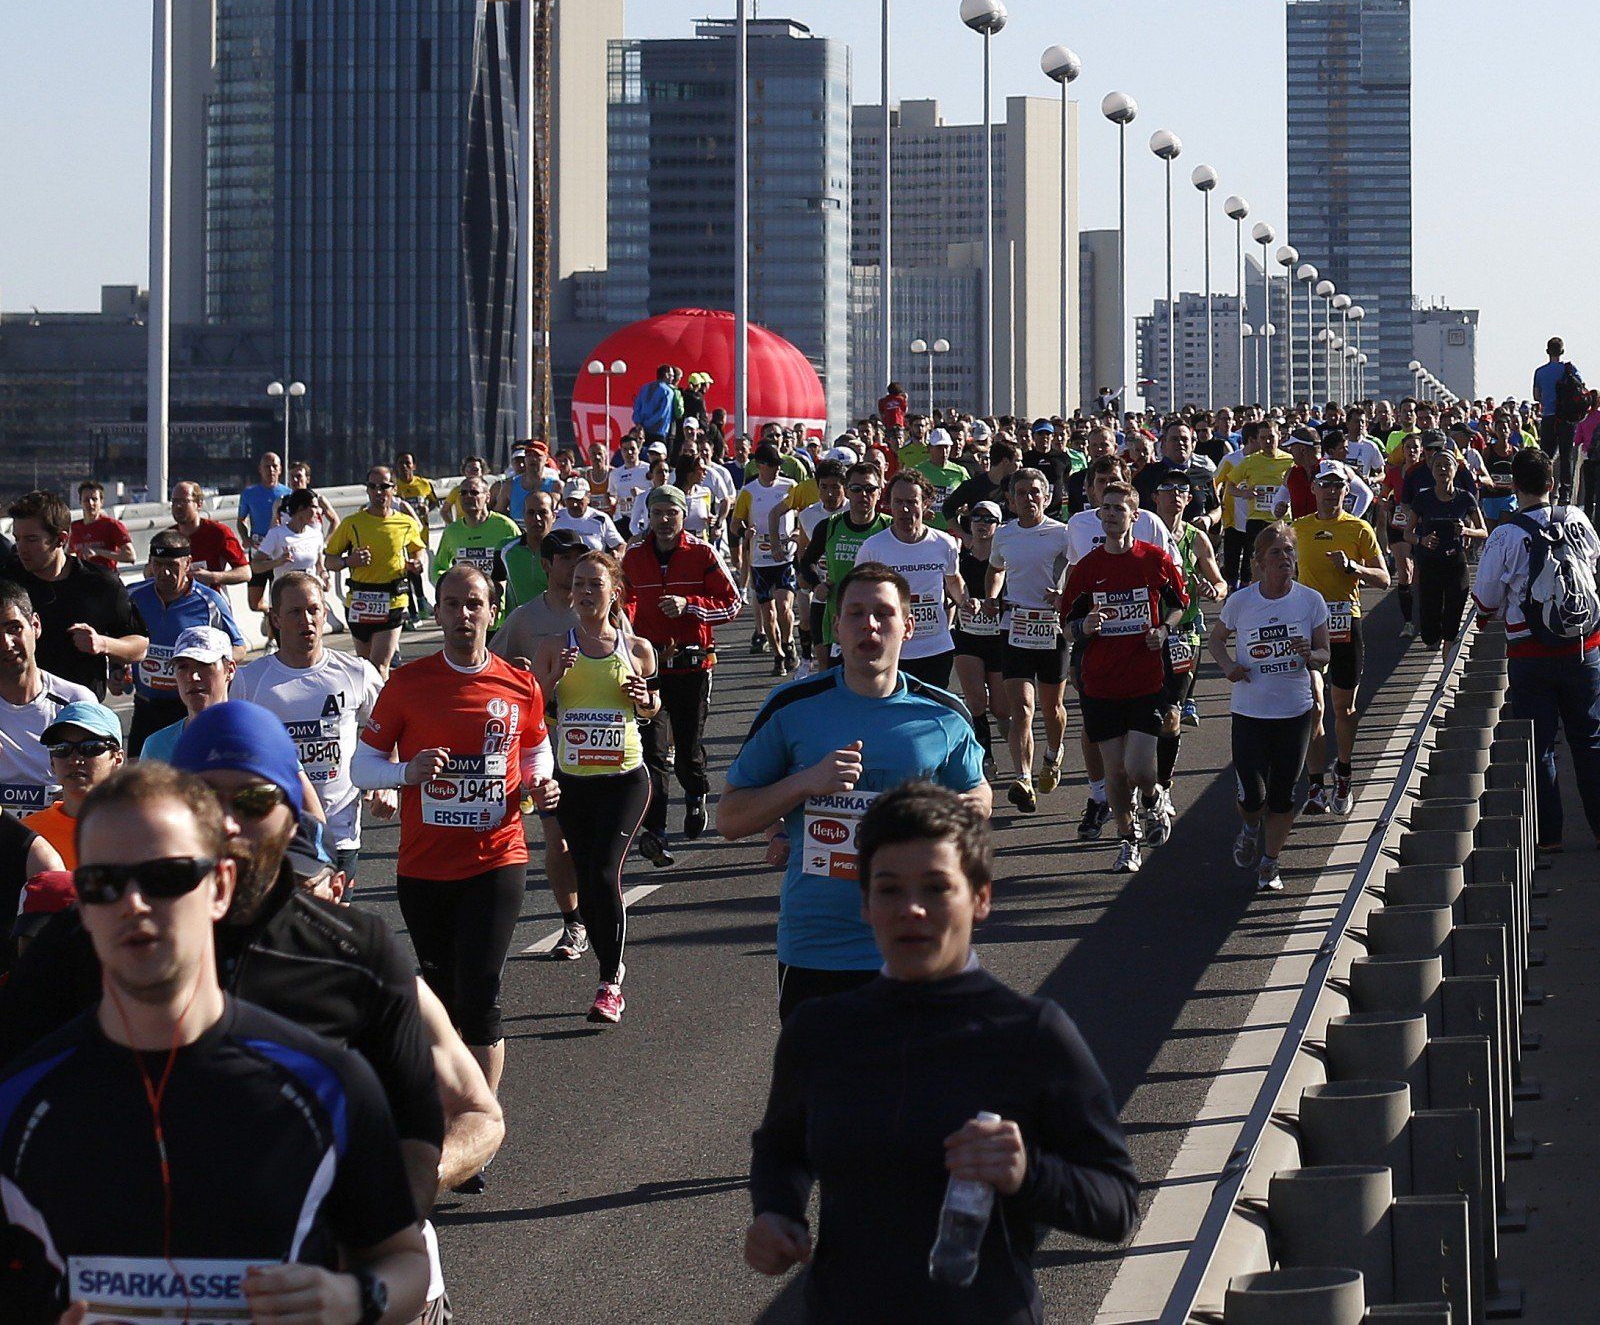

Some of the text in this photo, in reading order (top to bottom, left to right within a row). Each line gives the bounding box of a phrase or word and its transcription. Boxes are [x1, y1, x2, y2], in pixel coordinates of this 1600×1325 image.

[1108, 593, 1131, 602] OMV
[1262, 628, 1285, 639] OMV
[1260, 661, 1289, 674] ERSTE
[565, 712, 614, 722] SPARKASSE
[286, 725, 317, 736] OMV
[589, 727, 621, 748] 6730
[298, 741, 341, 766] 19540
[447, 759, 481, 771] OMV
[4, 789, 40, 801] OMV
[427, 779, 505, 804] Hervis 19413
[434, 810, 479, 826] ERSTE
[813, 823, 846, 840] Hervis
[78, 1268, 241, 1299] SPARKASSE
